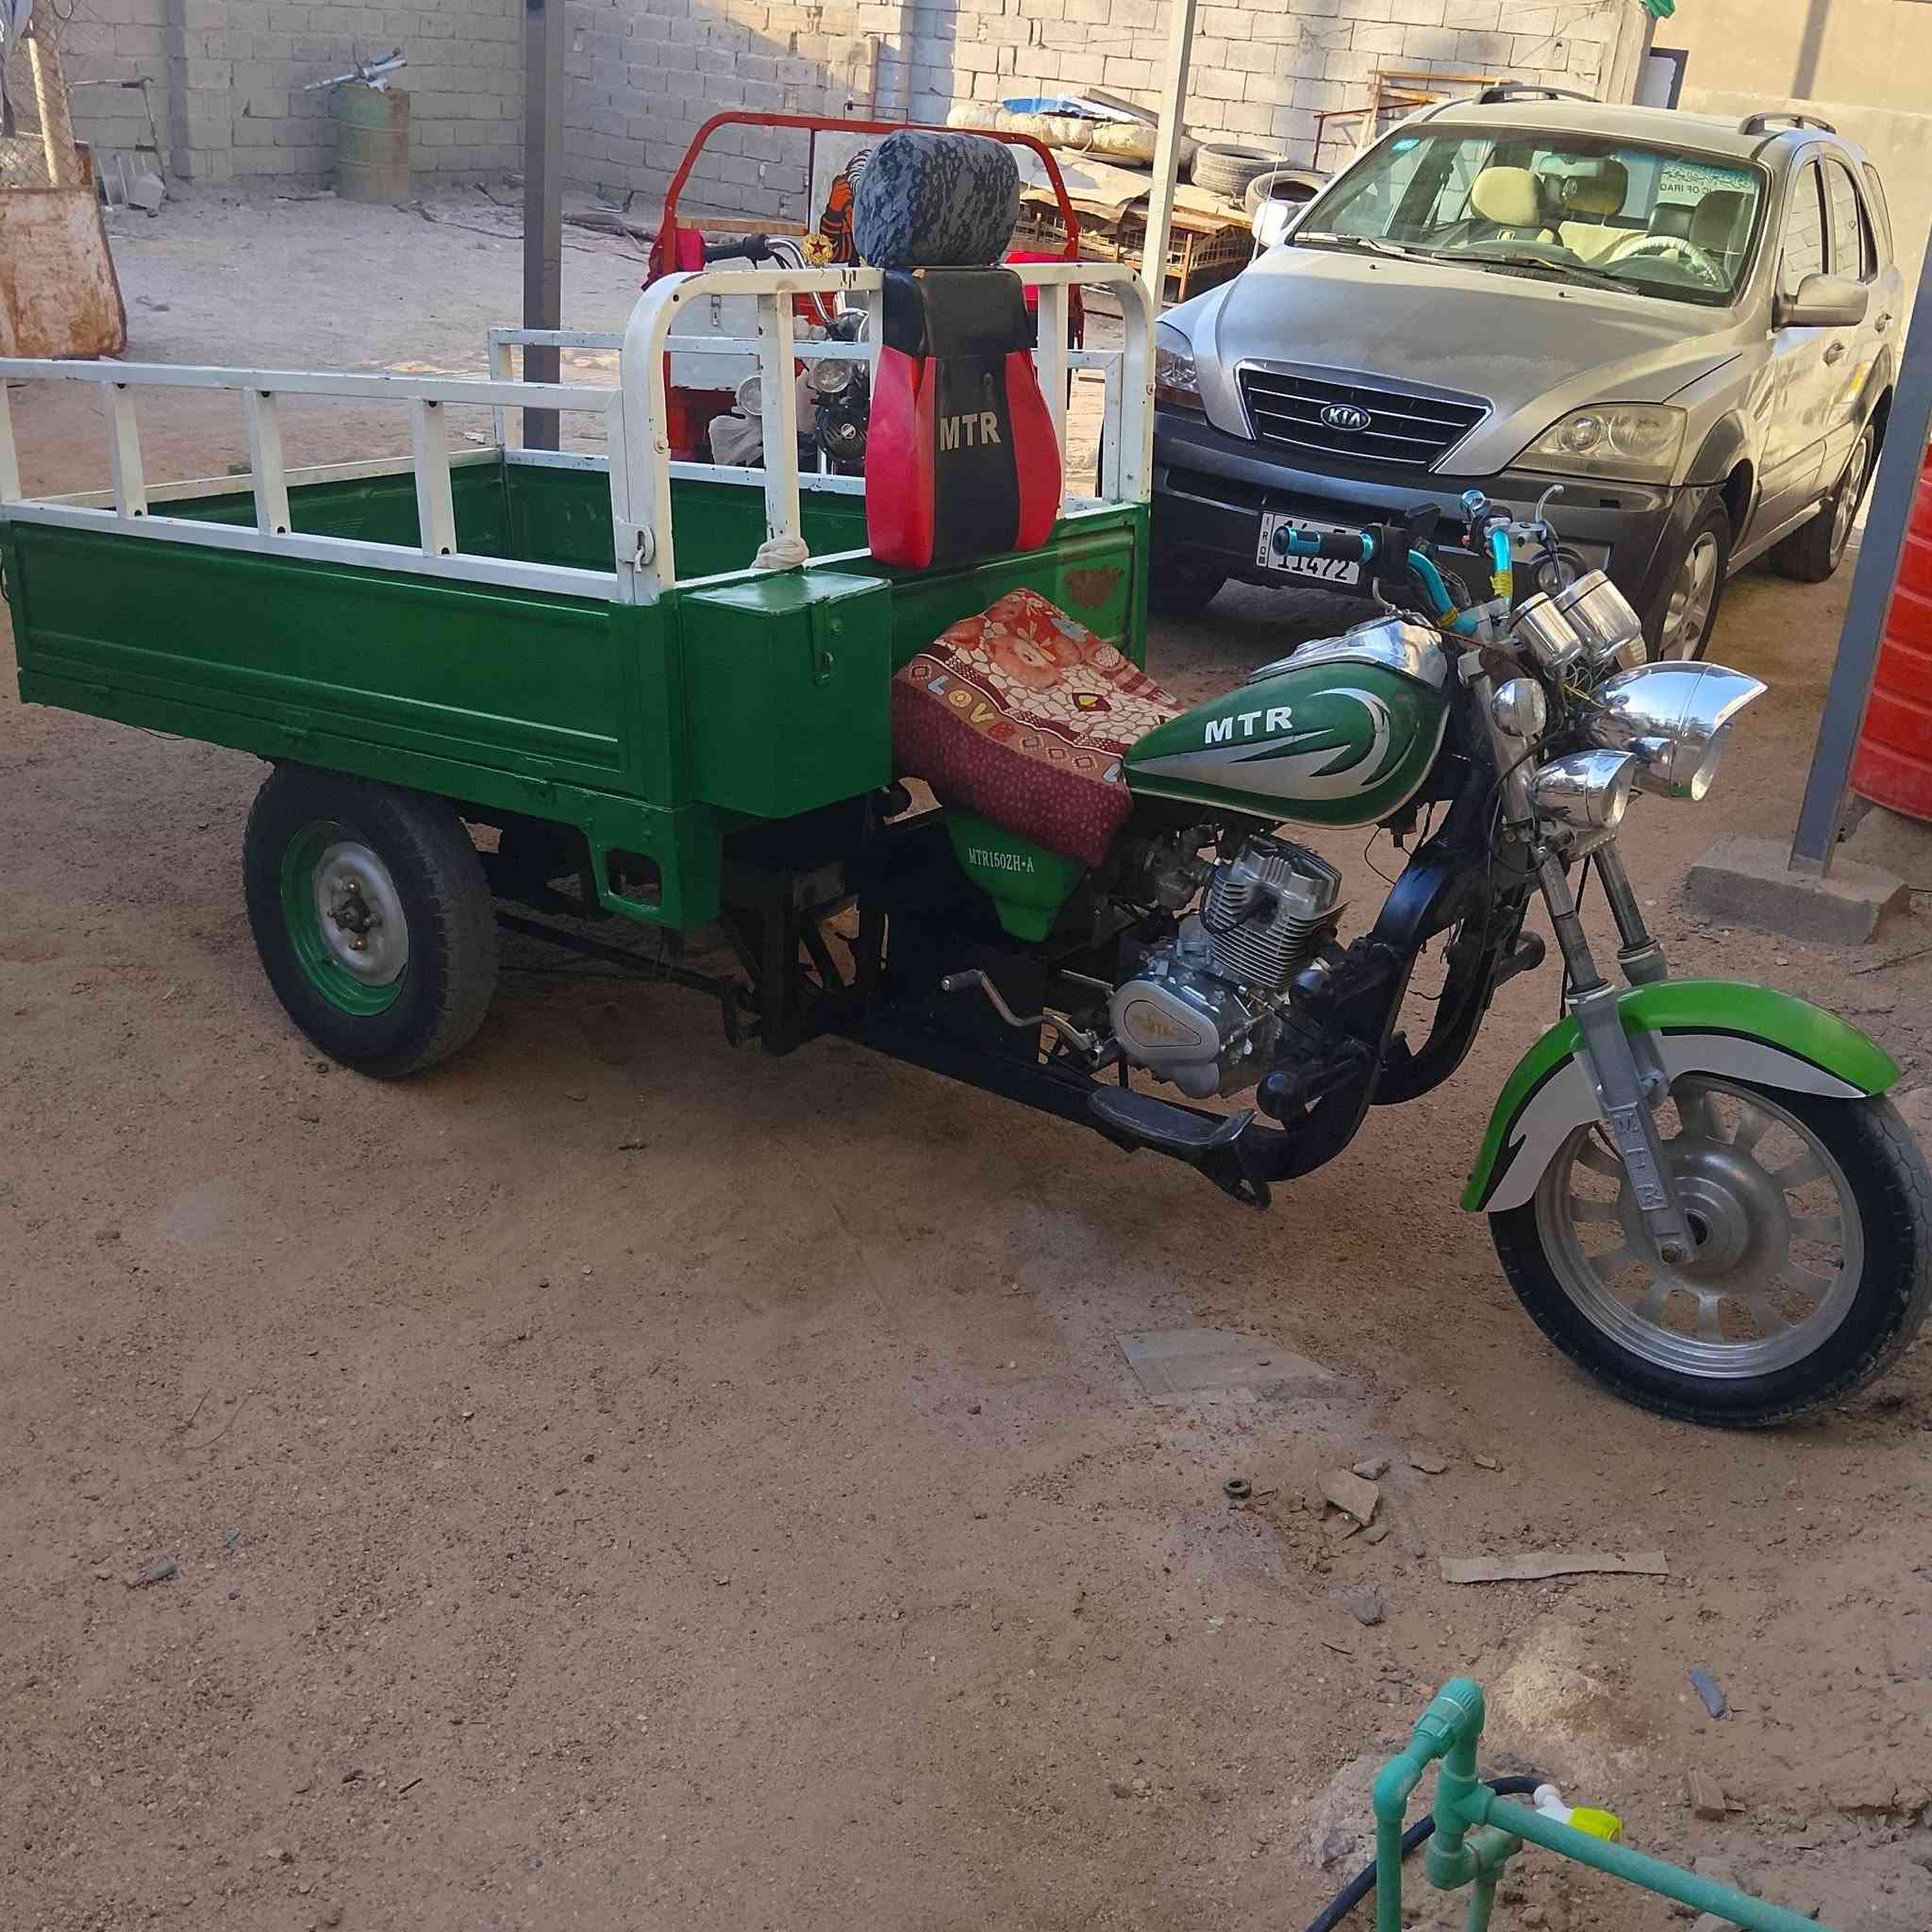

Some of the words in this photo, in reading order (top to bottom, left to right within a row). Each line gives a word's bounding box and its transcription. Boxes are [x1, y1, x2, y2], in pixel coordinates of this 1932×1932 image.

[940, 410, 1001, 451] MTR
[1325, 406, 1361, 427] KIA
[1205, 707, 1293, 744] MTR
